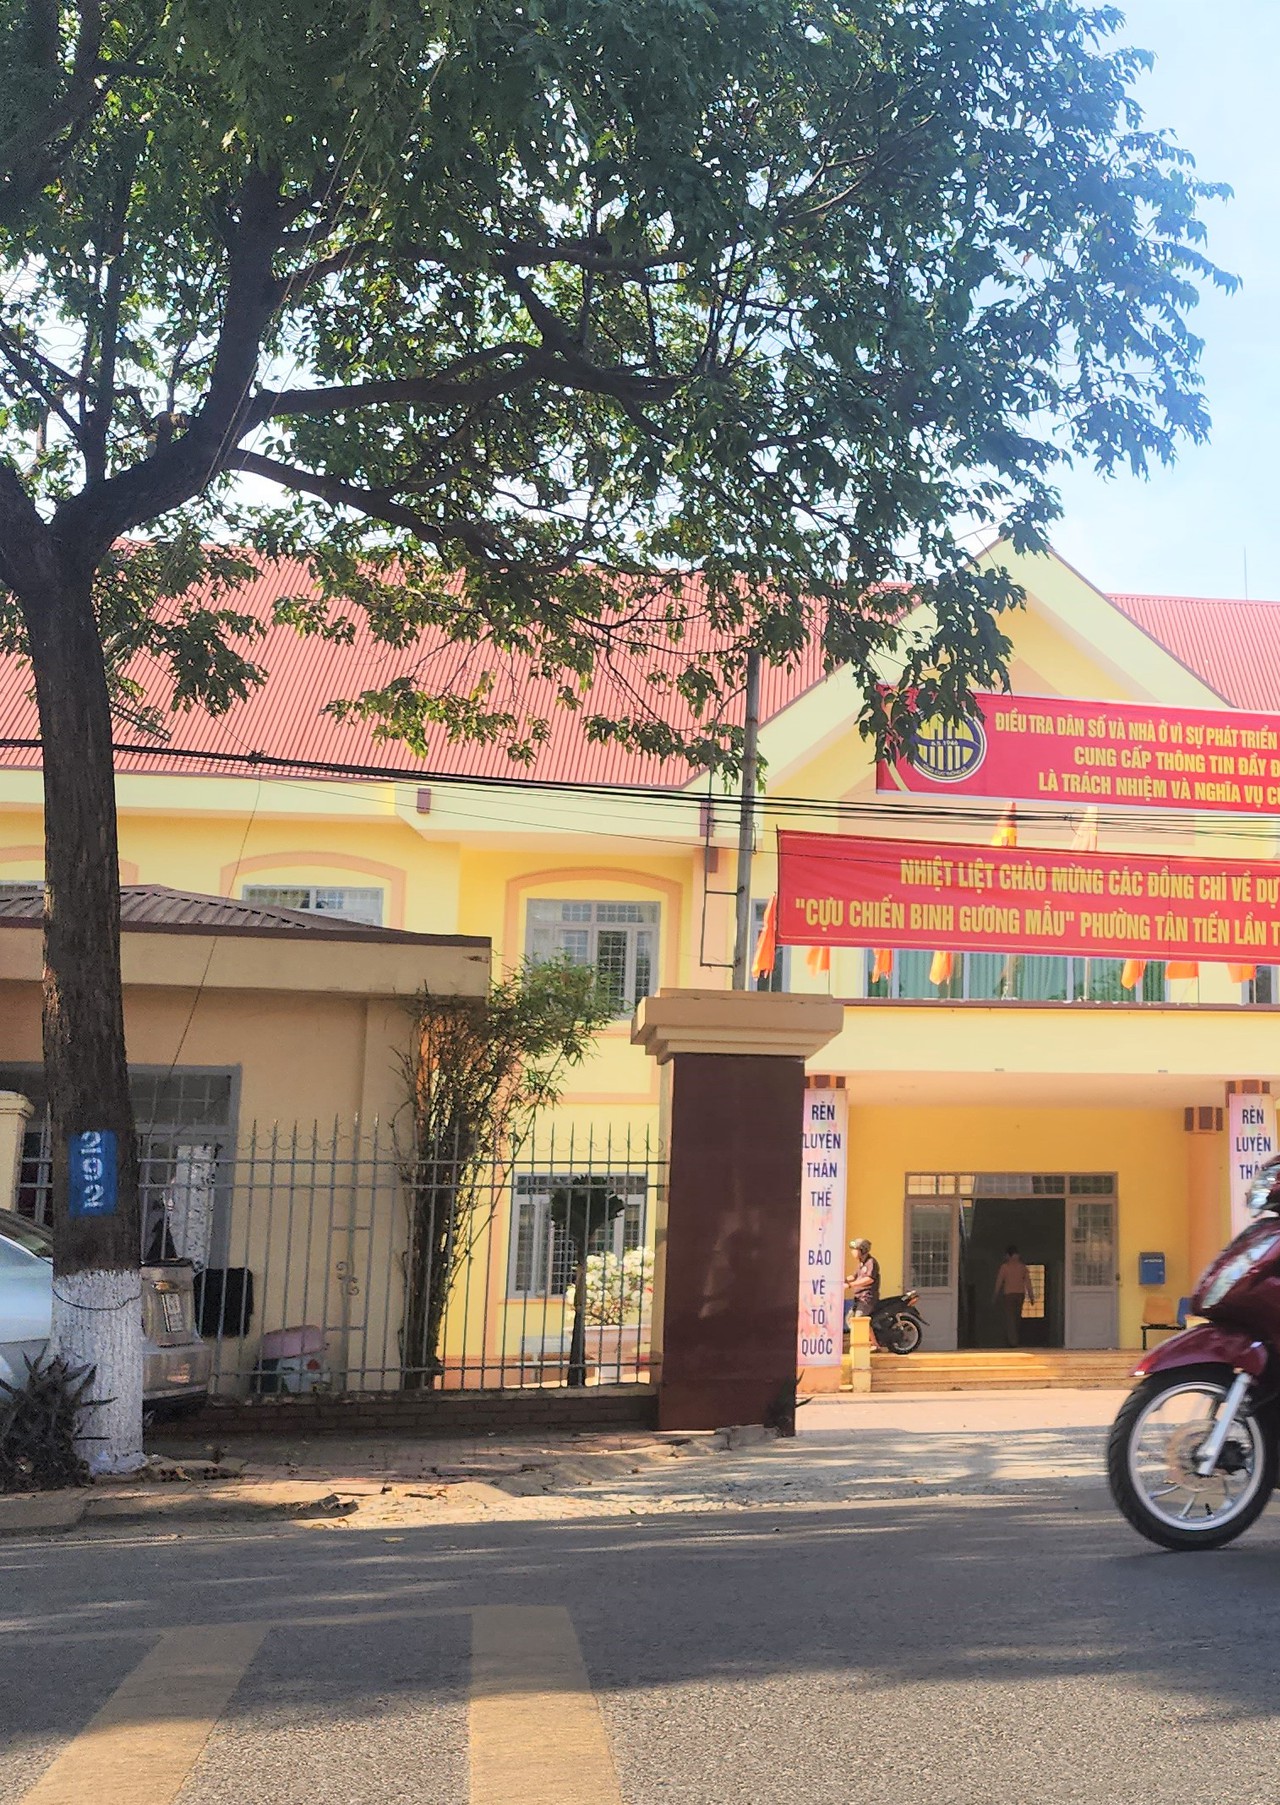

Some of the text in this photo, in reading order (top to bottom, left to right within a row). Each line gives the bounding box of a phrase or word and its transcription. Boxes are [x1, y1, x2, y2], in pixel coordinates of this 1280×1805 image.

[995, 707, 1026, 733] ĐIỀU
[1029, 715, 1054, 735] TRA
[1057, 714, 1084, 737] DÂN
[1088, 714, 1106, 738] SỐ
[1108, 717, 1126, 740] VÀ
[1129, 719, 1156, 742] NHÀ
[1159, 719, 1168, 743] Ở
[1170, 721, 1182, 743] VÌ
[1186, 725, 1204, 748] SỰ
[1207, 725, 1239, 748] PHÁT
[1240, 725, 1277, 750] TRIỂN
[1074, 746, 1117, 767] CUNG
[1120, 745, 1152, 769] CẤP
[1156, 750, 1205, 773] THÔNG
[1209, 755, 1234, 775] TIN
[1238, 752, 1267, 777] ĐẦY
[1038, 769, 1058, 792] LÀ
[1061, 770, 1111, 794] TRÁCH
[1116, 775, 1167, 801] NHIỆM
[1171, 777, 1191, 800] VÀ
[1194, 780, 1241, 803] NGHĨA
[1244, 785, 1262, 808] VỤ
[900, 855, 954, 892] NHIỆT
[958, 857, 994, 894] LIỆT
[999, 860, 1047, 891] CHÀO
[1051, 863, 1103, 895] MỪNG
[1108, 865, 1144, 897] CÁC
[1148, 865, 1194, 899] ĐỒNG
[1199, 870, 1227, 901] CHÍ
[1230, 869, 1252, 902] VỀ
[1256, 878, 1279, 908] DỰ
[795, 897, 844, 932] "CỰU
[849, 894, 905, 930] CHIẾN
[910, 904, 953, 931] BINH
[959, 906, 1020, 935] GƯƠNG
[1024, 900, 1074, 937] MẪU"
[1080, 908, 1150, 941] PHƯỜNG
[1155, 911, 1188, 942] TÂN
[1192, 910, 1230, 944] TIẾN
[1234, 911, 1267, 947] LẦN
[811, 1101, 835, 1120] RÈN
[1242, 1105, 1264, 1124] RÈN
[803, 1130, 841, 1153] LUYỆN
[1236, 1133, 1271, 1155] LUYỆN
[80, 1131, 104, 1208] 292
[807, 1159, 838, 1178] THÂN
[1239, 1163, 1263, 1180] THÂ
[808, 1244, 831, 1265] BẢO
[812, 1275, 826, 1299] VỆ
[801, 1332, 833, 1356] QUỐC
